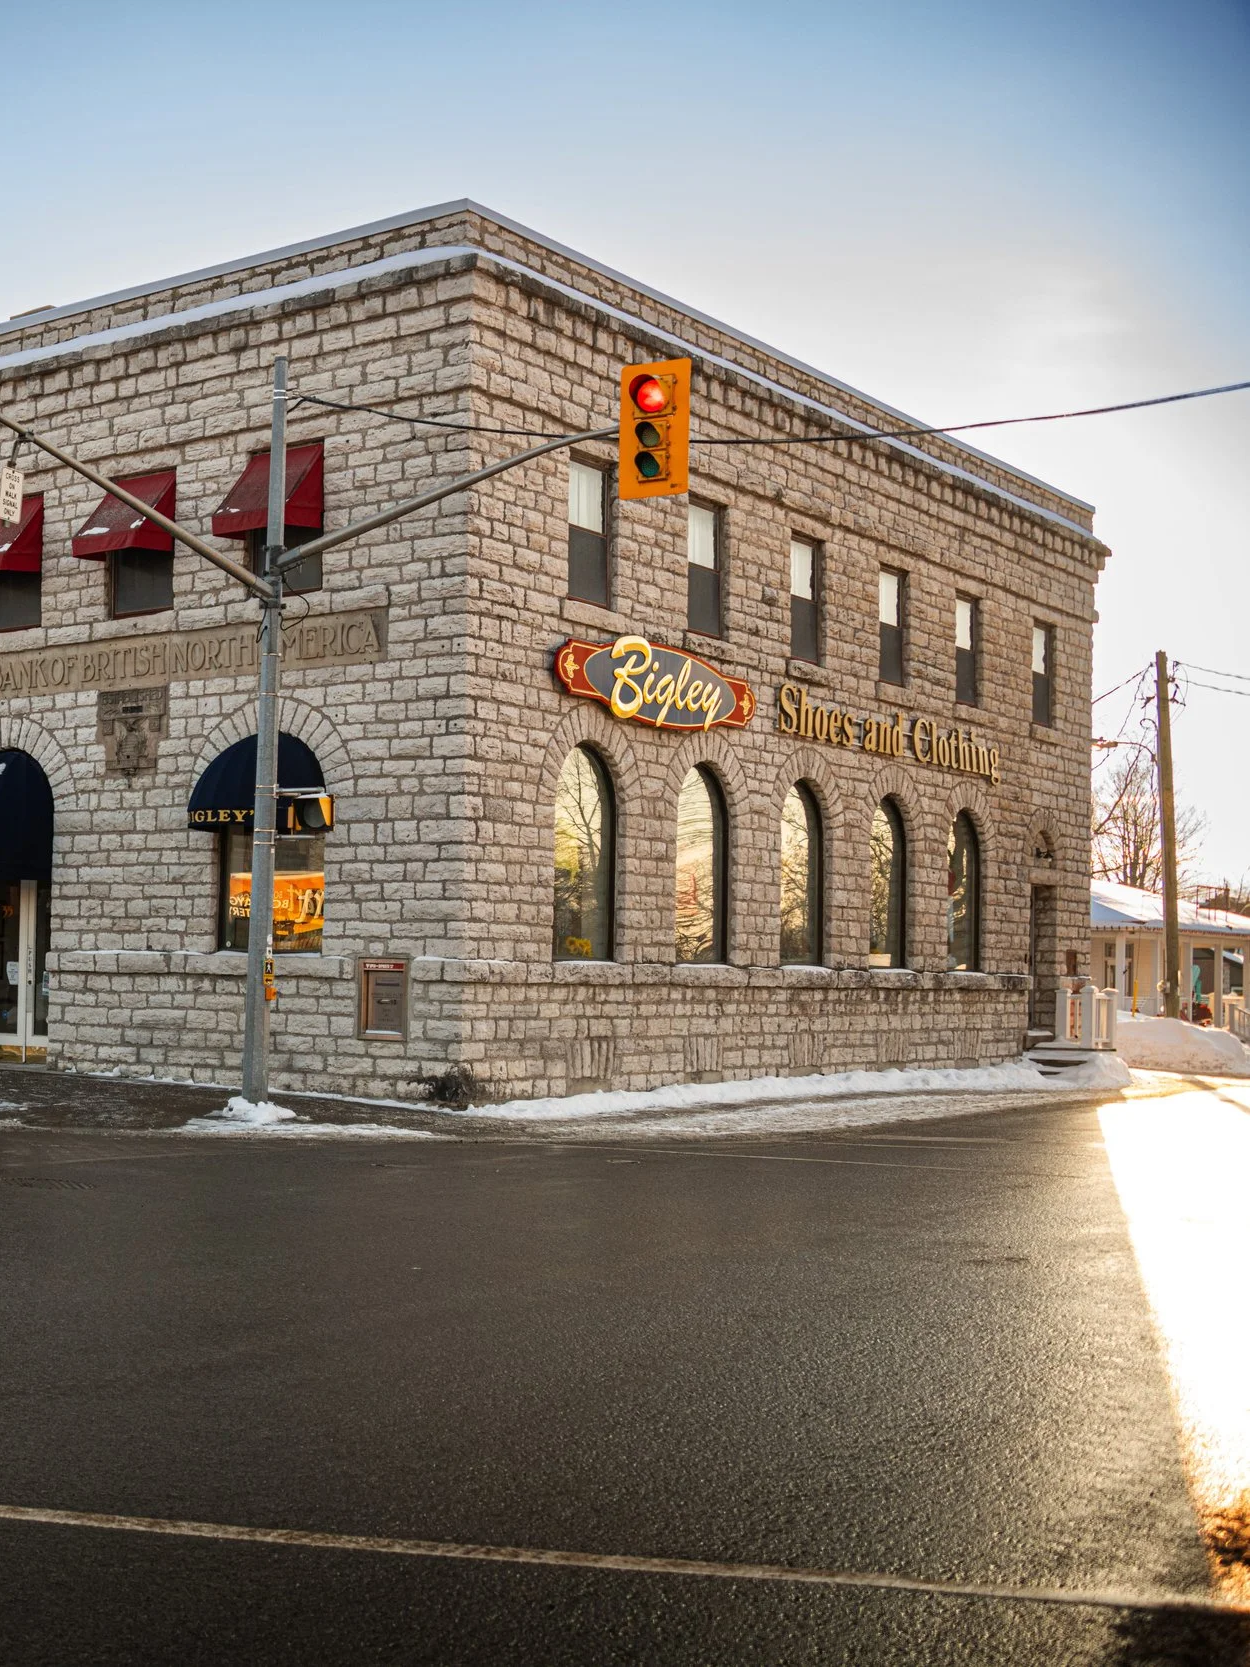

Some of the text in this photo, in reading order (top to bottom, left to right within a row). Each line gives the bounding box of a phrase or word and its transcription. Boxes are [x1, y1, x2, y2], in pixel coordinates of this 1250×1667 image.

[5, 472, 20, 484] CROSS
[8, 482, 16, 490] ON
[5, 490, 17, 499] WALK
[2, 498, 18, 510] SIGNAL
[3, 507, 16, 517] ONLY
[51, 655, 79, 687] OF
[81, 642, 167, 683] BRITISH
[171, 634, 255, 674] NORTH
[261, 613, 381, 671] MERICA
[611, 635, 723, 732] Bigley
[778, 683, 1000, 786] Shoes and Clothing
